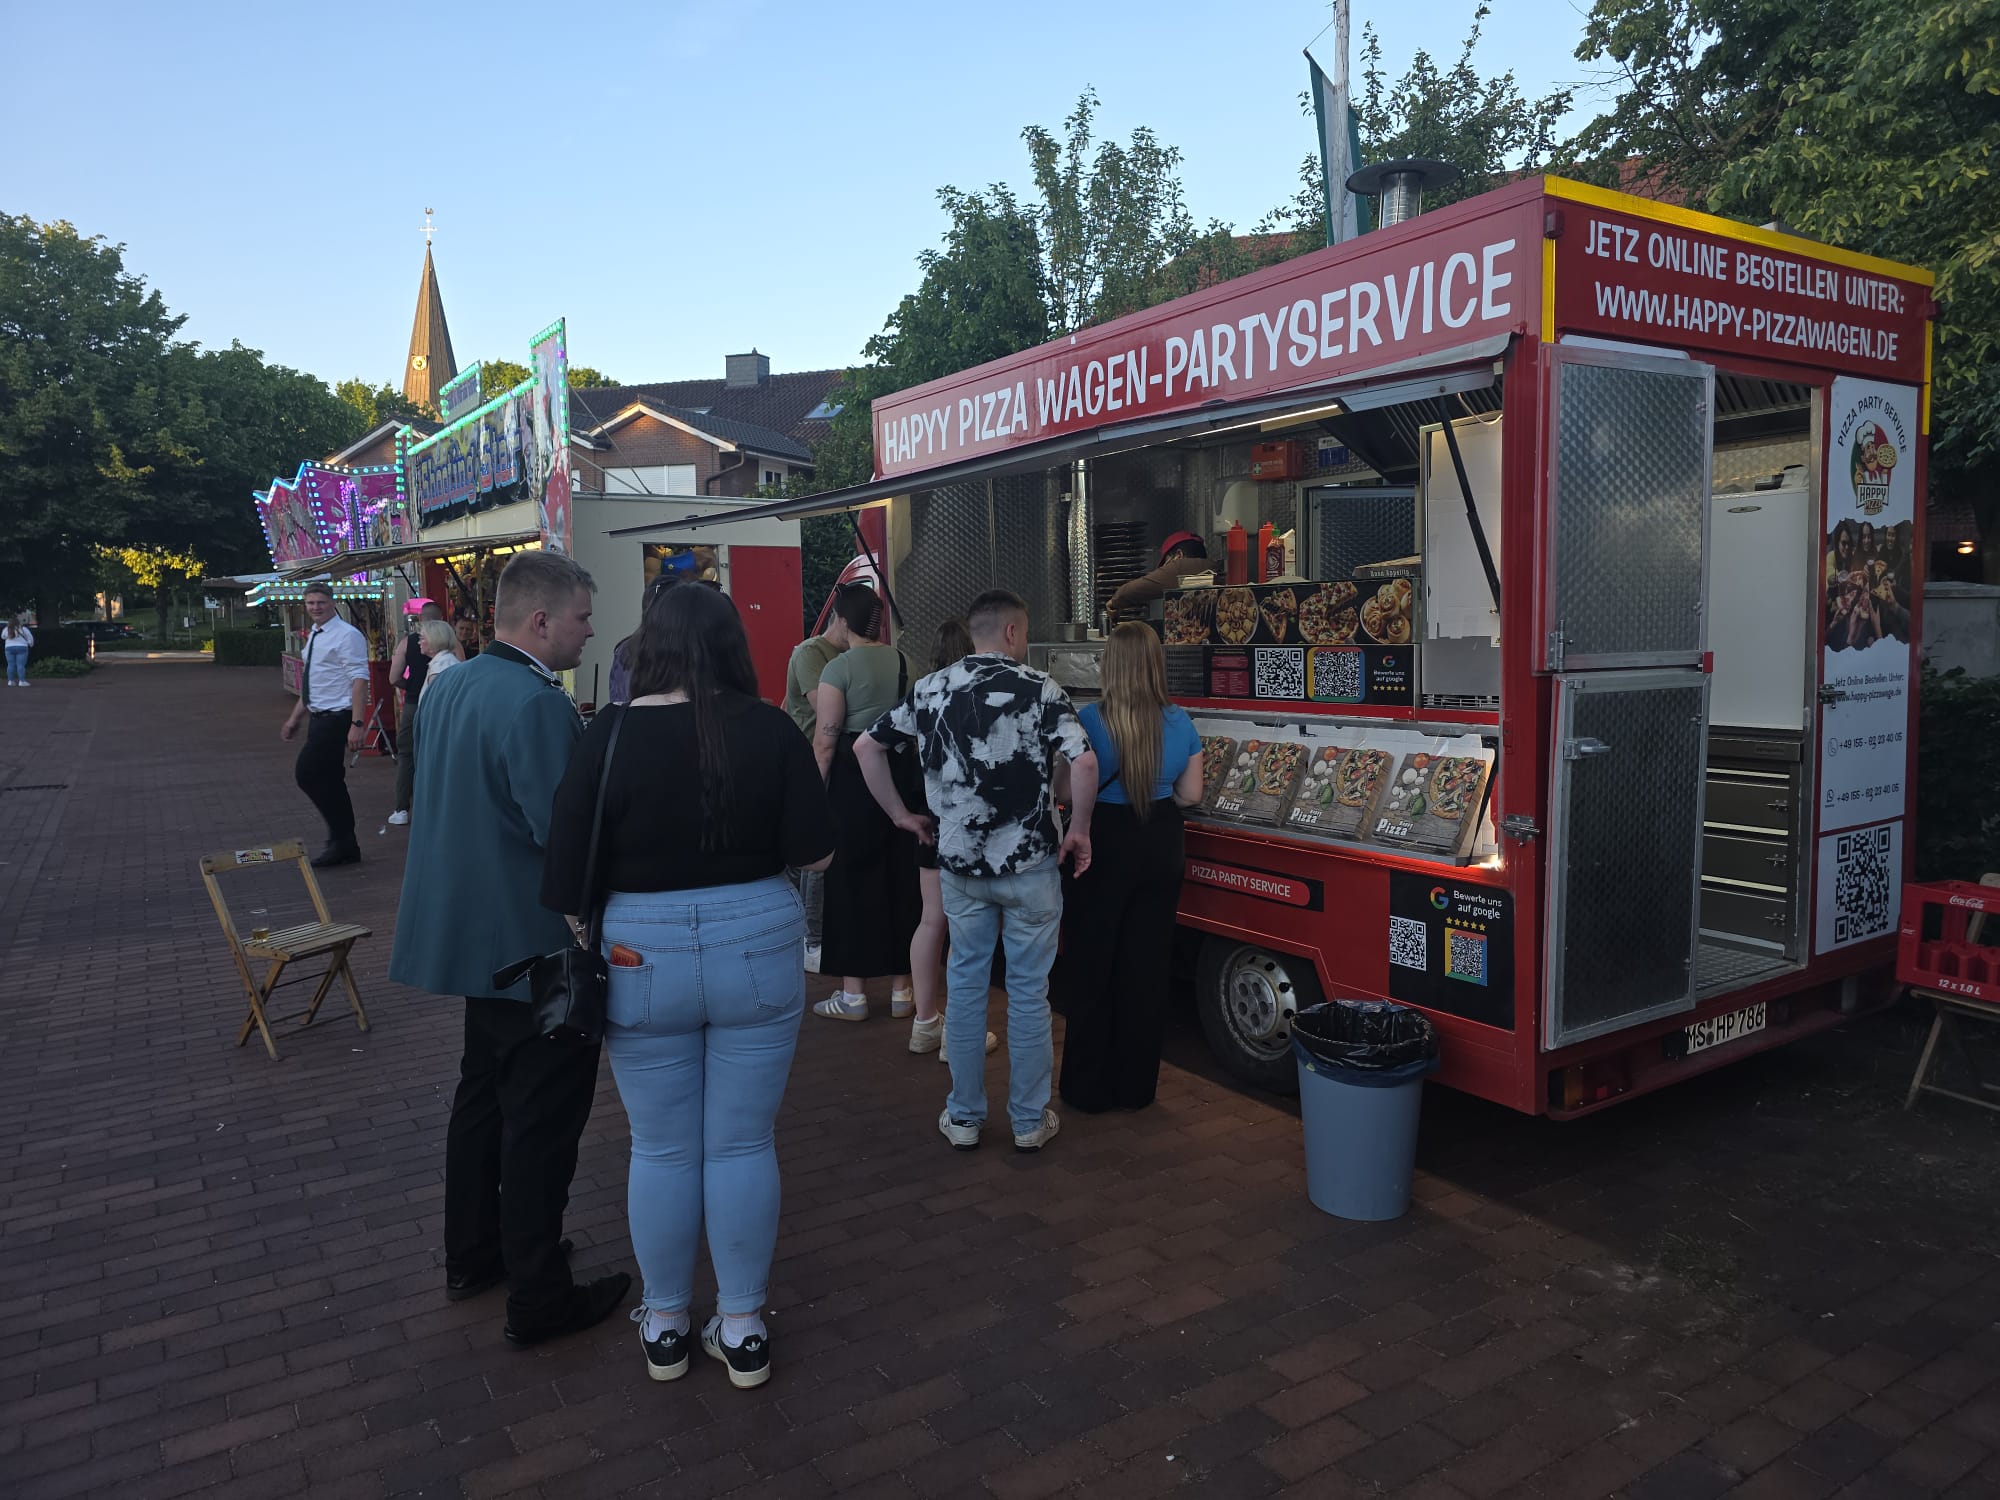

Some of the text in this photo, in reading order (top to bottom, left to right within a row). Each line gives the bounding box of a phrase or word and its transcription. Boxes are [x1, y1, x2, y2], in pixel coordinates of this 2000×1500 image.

[1584, 219, 1905, 314] JETZ ONLINE BESTELLEN UNTER:
[1594, 281, 1898, 361] WWW.HAPPY-PIZZAWAGEN.DE
[885, 238, 1516, 465] HAPYY PIZZA WAGEN-PARTYSERVICE
[1837, 396, 1907, 454] PIZZA PARTY SERVICE
[1859, 486, 1887, 503] HAPPY
[1216, 796, 1240, 811] Pizza
[1290, 808, 1318, 823] Pizza
[1375, 818, 1409, 836] Pizza
[1191, 865, 1292, 898] PIZZA PARTY SERVICE
[1453, 890, 1502, 907] Bewerte uns
[1457, 904, 1501, 920] auf google
[1938, 979, 1949, 988] 12
[1686, 1002, 1765, 1049] MS HP 786
